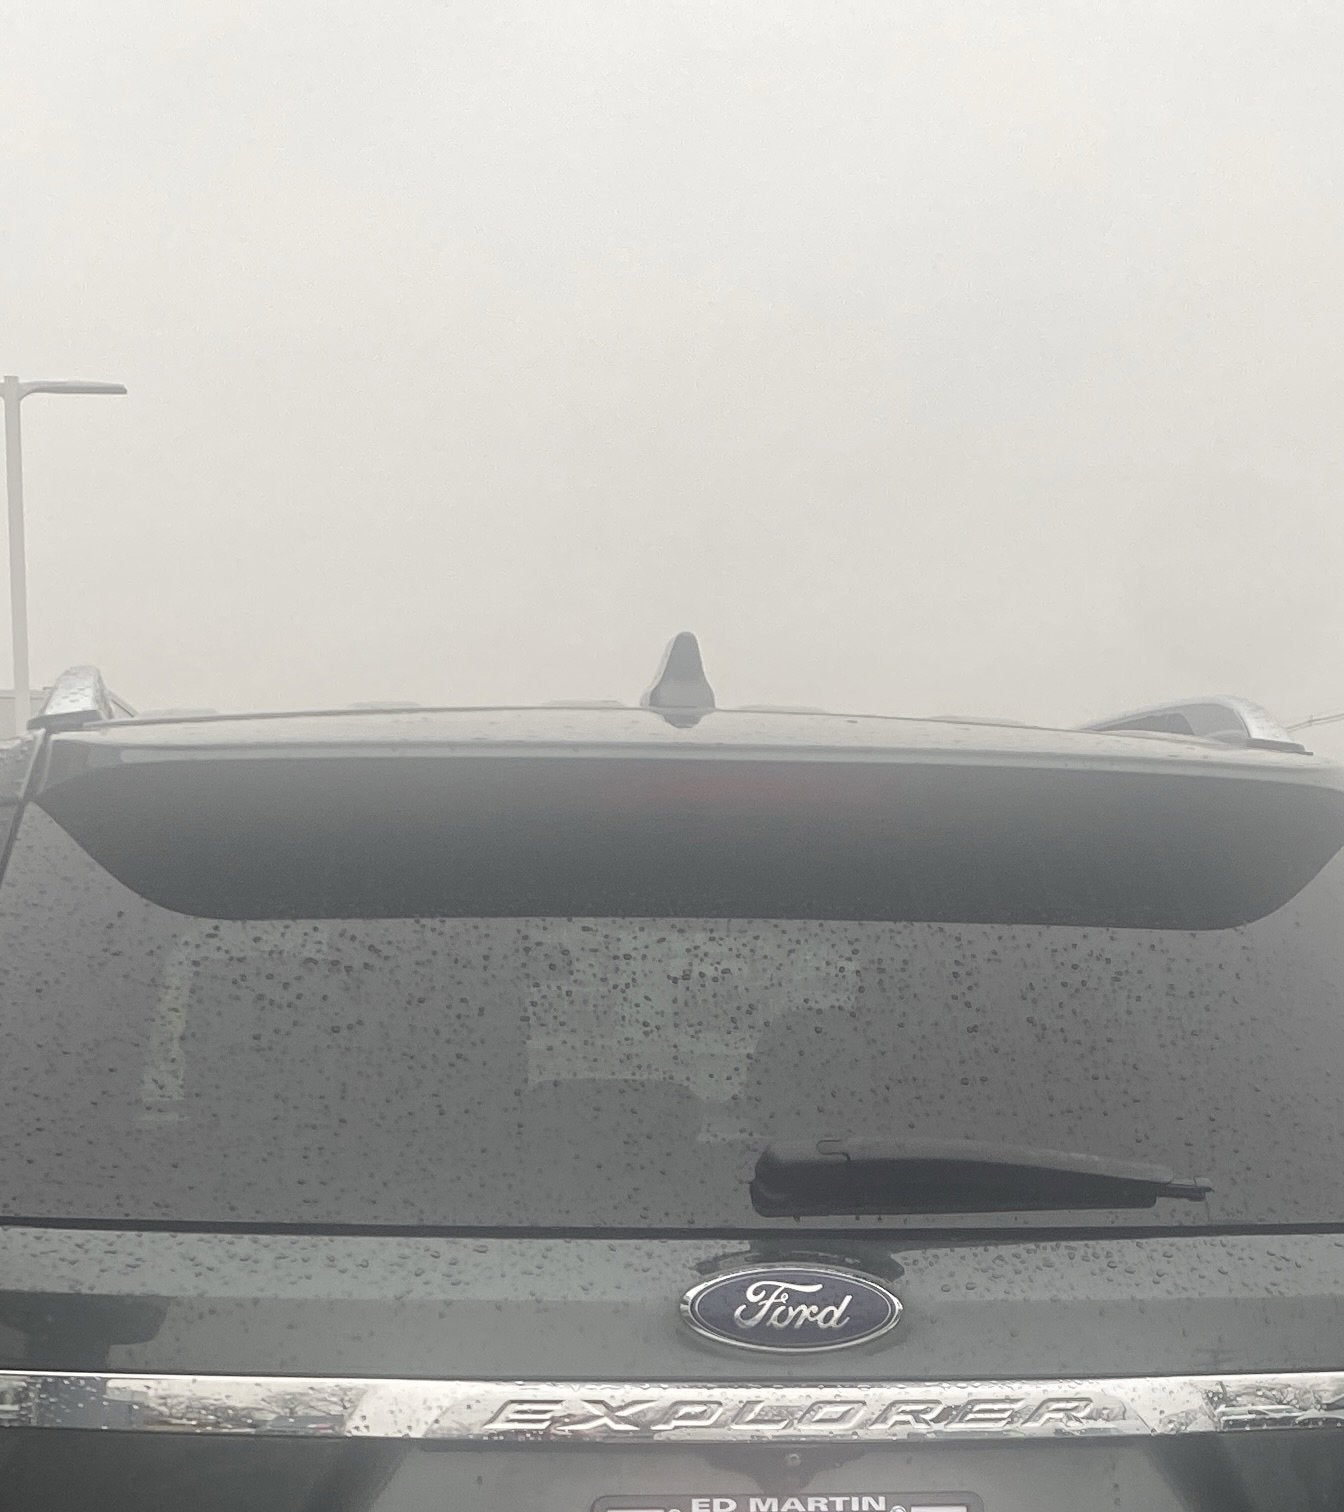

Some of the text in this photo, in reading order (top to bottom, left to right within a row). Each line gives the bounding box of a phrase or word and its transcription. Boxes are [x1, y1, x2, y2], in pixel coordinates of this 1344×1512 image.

[734, 1280, 852, 1329] Ford
[483, 1398, 1095, 1432] EXPLORER
[691, 1496, 886, 1512] ED MARTIN
